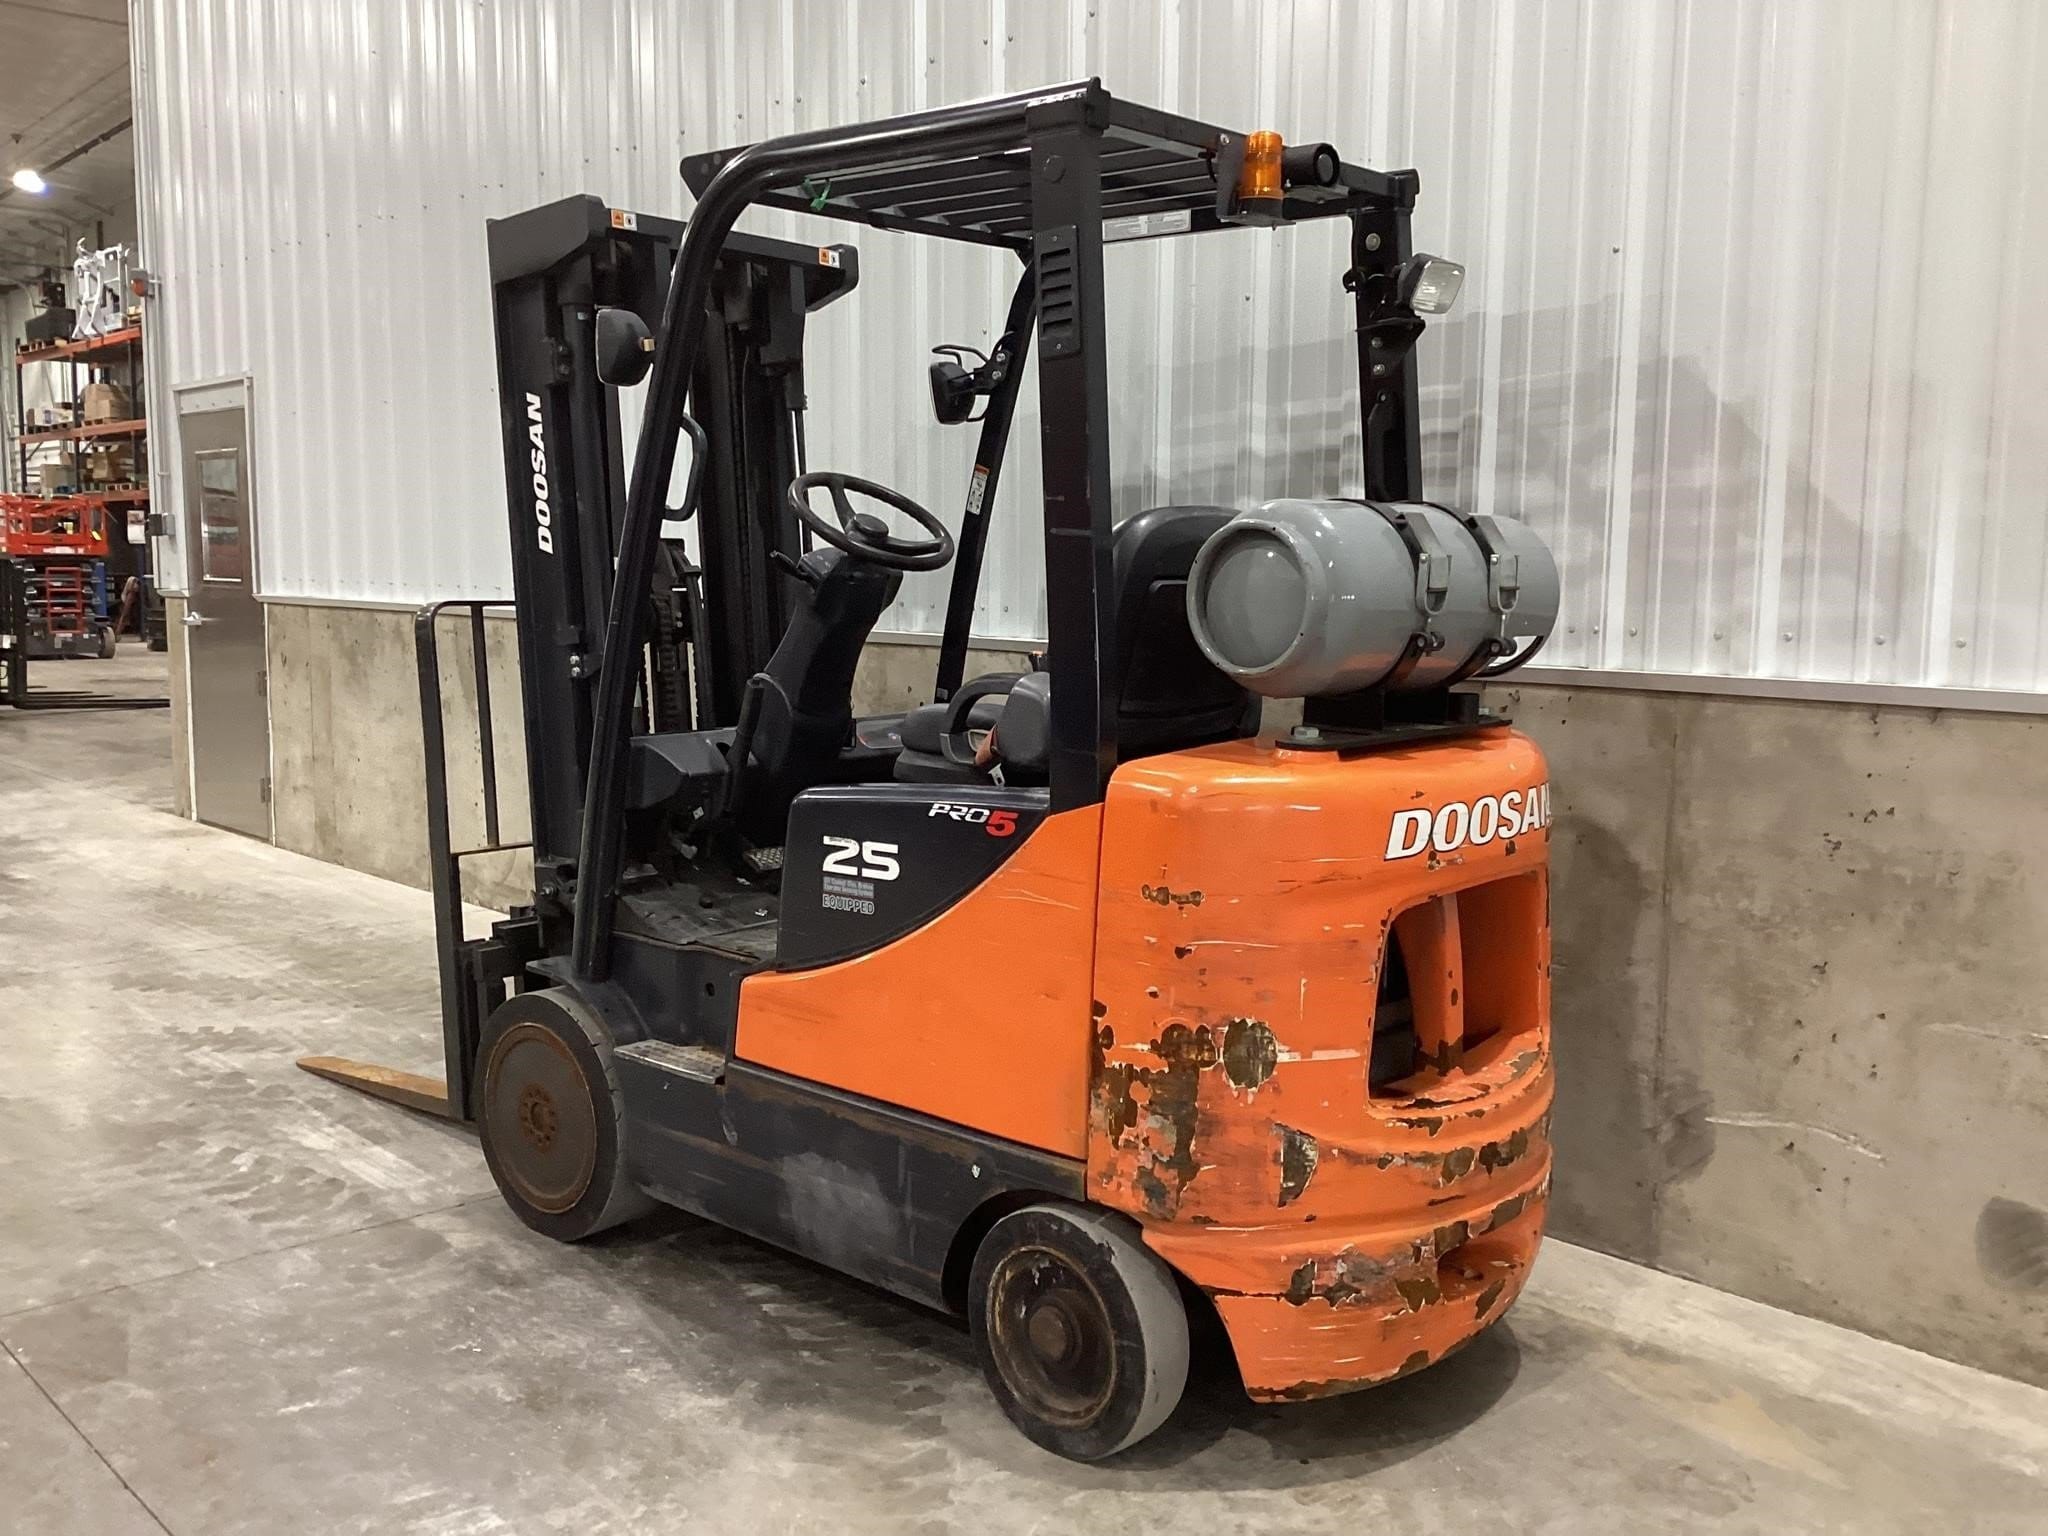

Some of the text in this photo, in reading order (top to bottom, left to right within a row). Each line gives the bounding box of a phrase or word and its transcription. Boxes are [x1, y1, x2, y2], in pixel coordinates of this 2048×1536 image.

[526, 392, 553, 555] DOOSAN
[822, 835, 900, 881] 25
[823, 893, 874, 915] EQUIPPED
